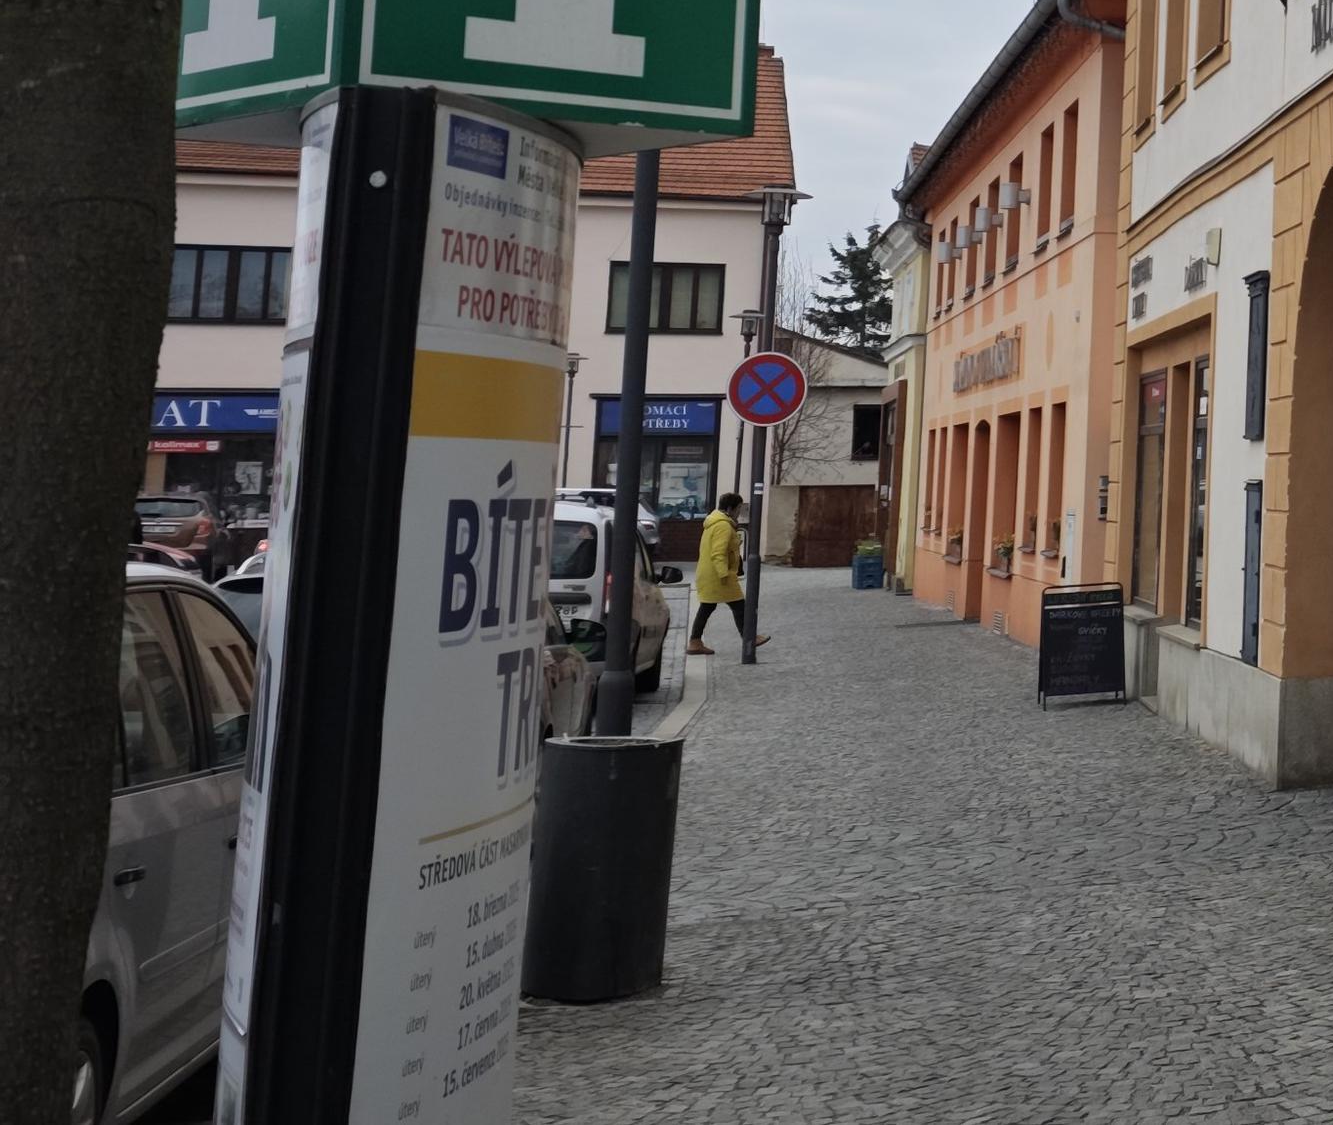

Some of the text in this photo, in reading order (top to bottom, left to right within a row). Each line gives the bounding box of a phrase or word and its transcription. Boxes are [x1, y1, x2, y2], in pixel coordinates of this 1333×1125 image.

[444, 181, 507, 218] Objednávky
[441, 227, 489, 269] TATO
[457, 284, 495, 323] PRO
[152, 400, 221, 427] AT
[418, 841, 478, 891] STŘEDOVÁ
[479, 837, 500, 870] ČÁST
[413, 924, 438, 950] úterý
[467, 901, 481, 929] 18.
[410, 966, 433, 992] úterý
[466, 940, 480, 969] 15.
[406, 1008, 429, 1035] úterý
[459, 982, 474, 1010] 20.
[402, 1051, 425, 1077] úterý
[457, 1022, 473, 1051] 17.
[442, 1069, 459, 1099] 15.
